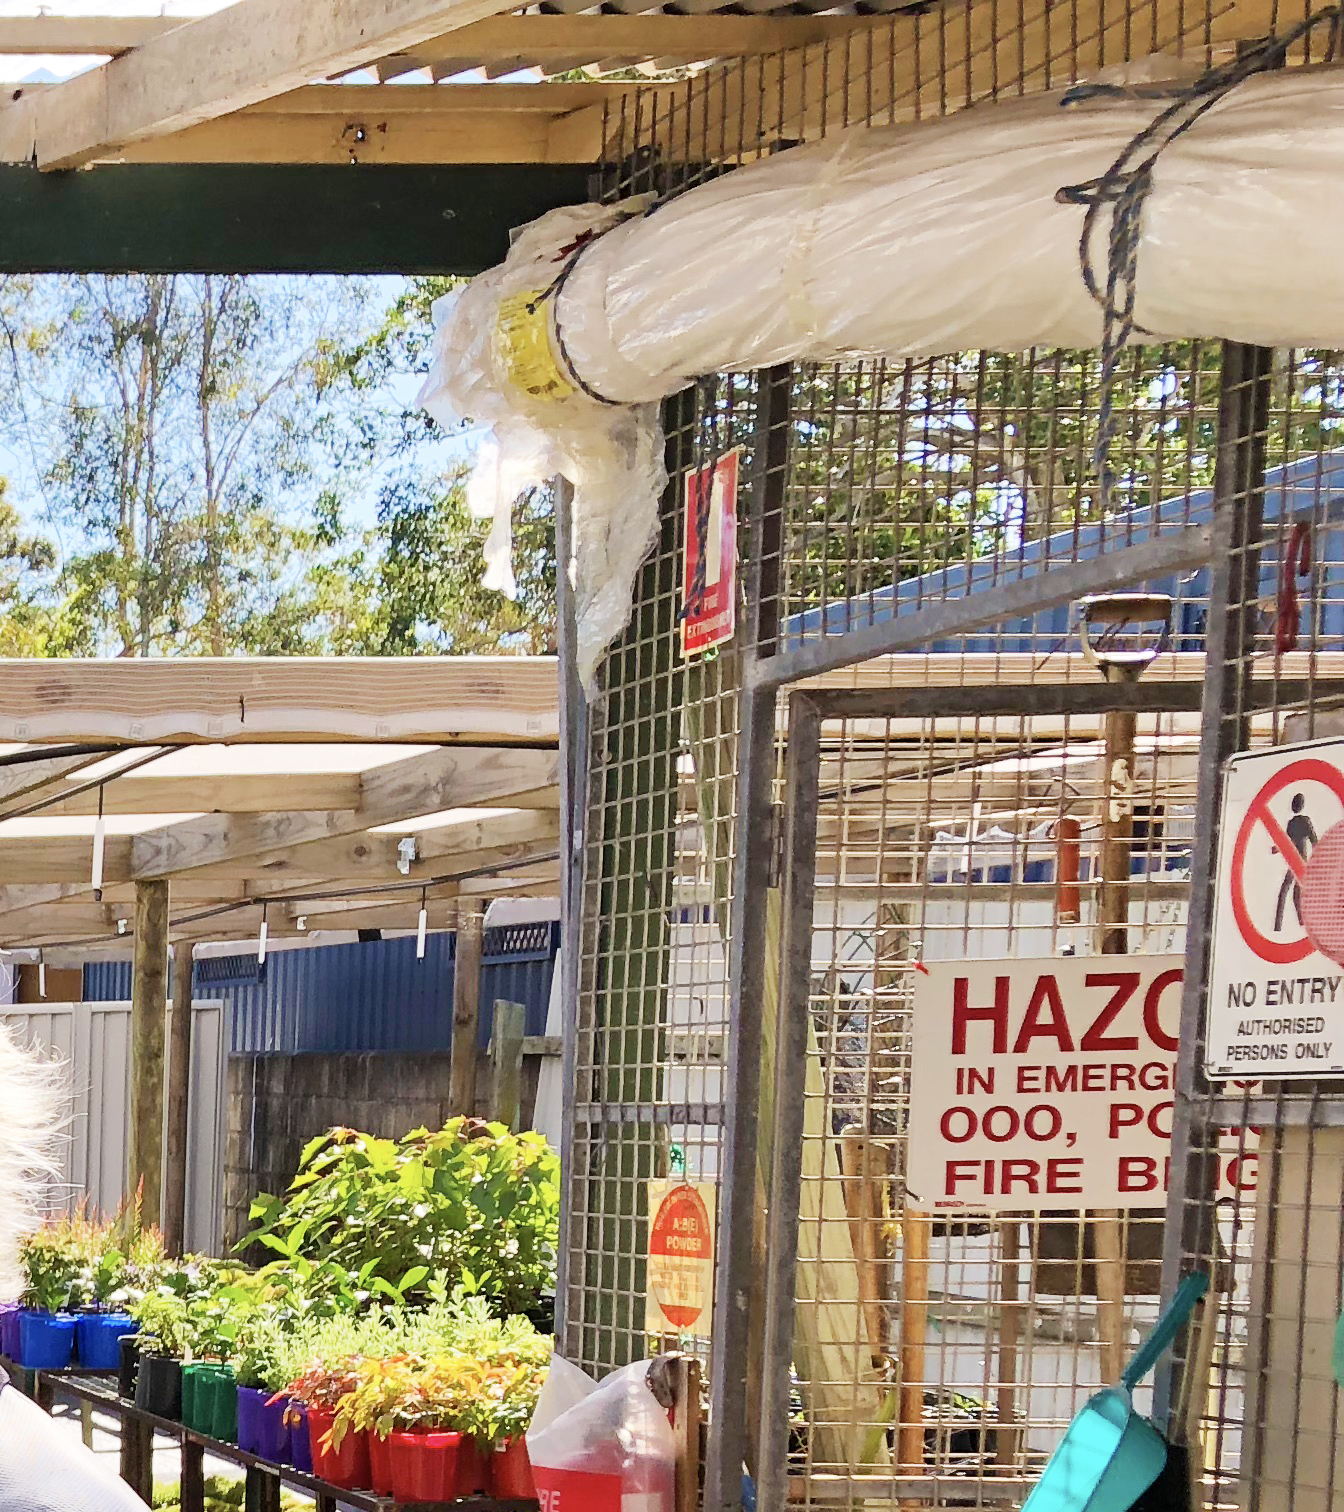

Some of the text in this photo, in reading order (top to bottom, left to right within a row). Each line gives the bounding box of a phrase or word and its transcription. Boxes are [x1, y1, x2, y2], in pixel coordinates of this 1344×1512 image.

[1227, 976, 1343, 1008] NO ENTRY
[1236, 1016, 1326, 1037] AUTHORISED
[1226, 1042, 1333, 1061] PERSONS ONLY
[955, 1061, 1178, 1096] IN EMERG
[944, 1157, 1084, 1196] FIRE
[666, 1235, 702, 1252] POWDER
